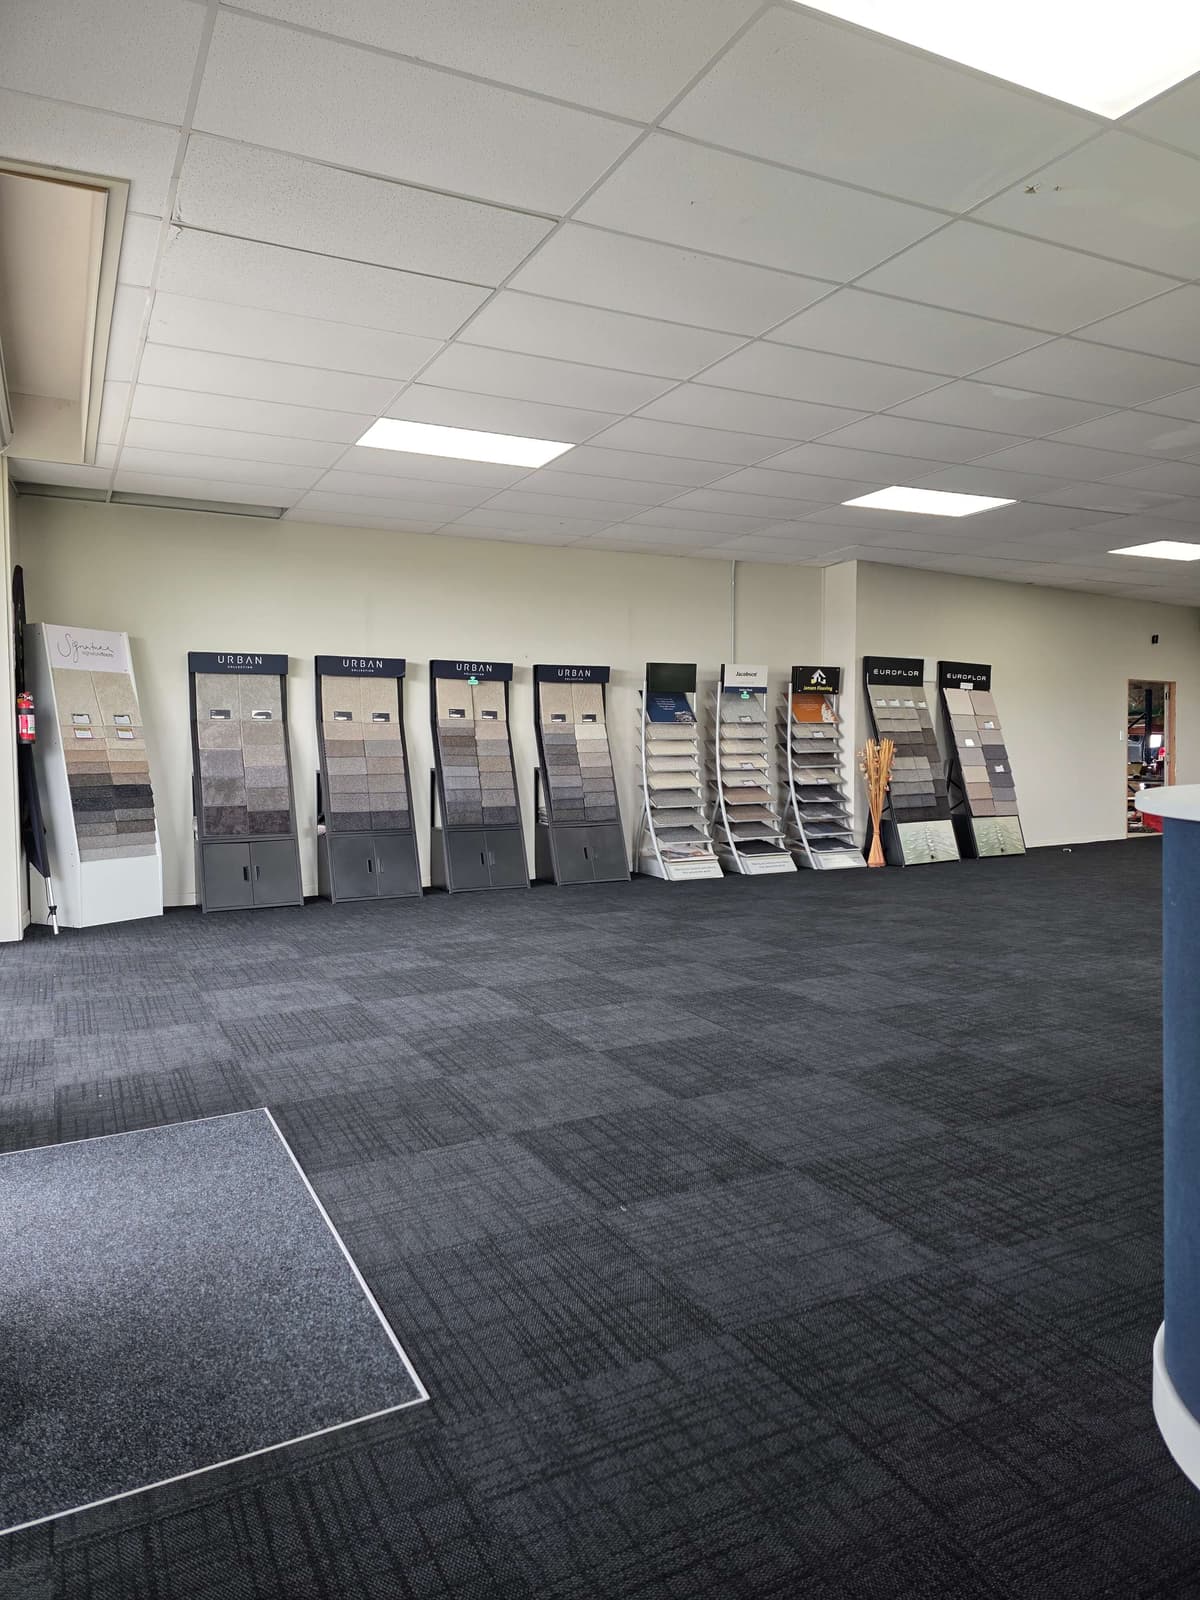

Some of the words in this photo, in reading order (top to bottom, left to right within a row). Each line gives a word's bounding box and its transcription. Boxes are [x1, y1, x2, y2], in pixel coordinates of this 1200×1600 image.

[217, 655, 263, 665] URBAN
[342, 659, 383, 668] URBAN
[456, 663, 493, 672] URBAN
[557, 668, 591, 677] URBAN
[873, 668, 919, 677] EUROFLOR
[946, 673, 987, 681] EUROFLOR
